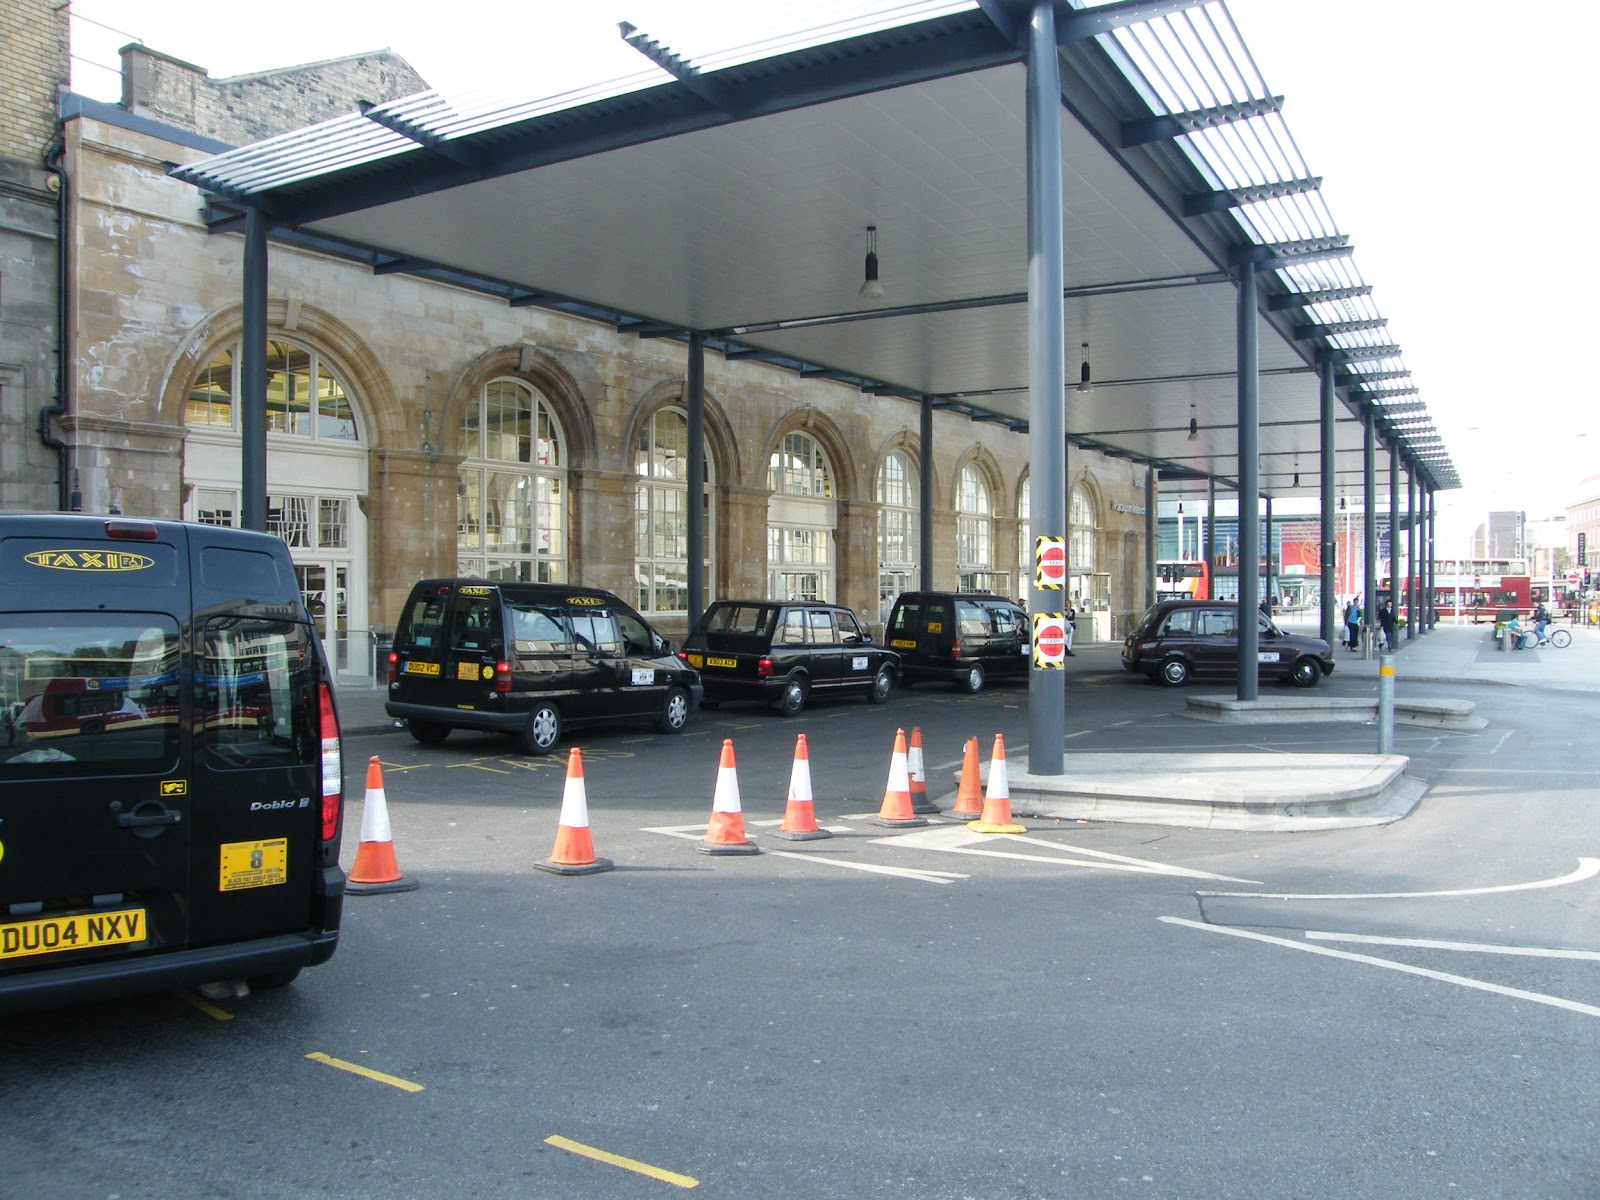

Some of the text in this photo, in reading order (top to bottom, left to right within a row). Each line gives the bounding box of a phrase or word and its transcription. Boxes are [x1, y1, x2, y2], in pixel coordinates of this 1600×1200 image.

[29, 552, 118, 570] TAXI
[568, 597, 595, 605] TAXI
[408, 662, 439, 673] DU02 VCJ
[250, 849, 264, 870] 8
[88, 913, 139, 942] NXV
